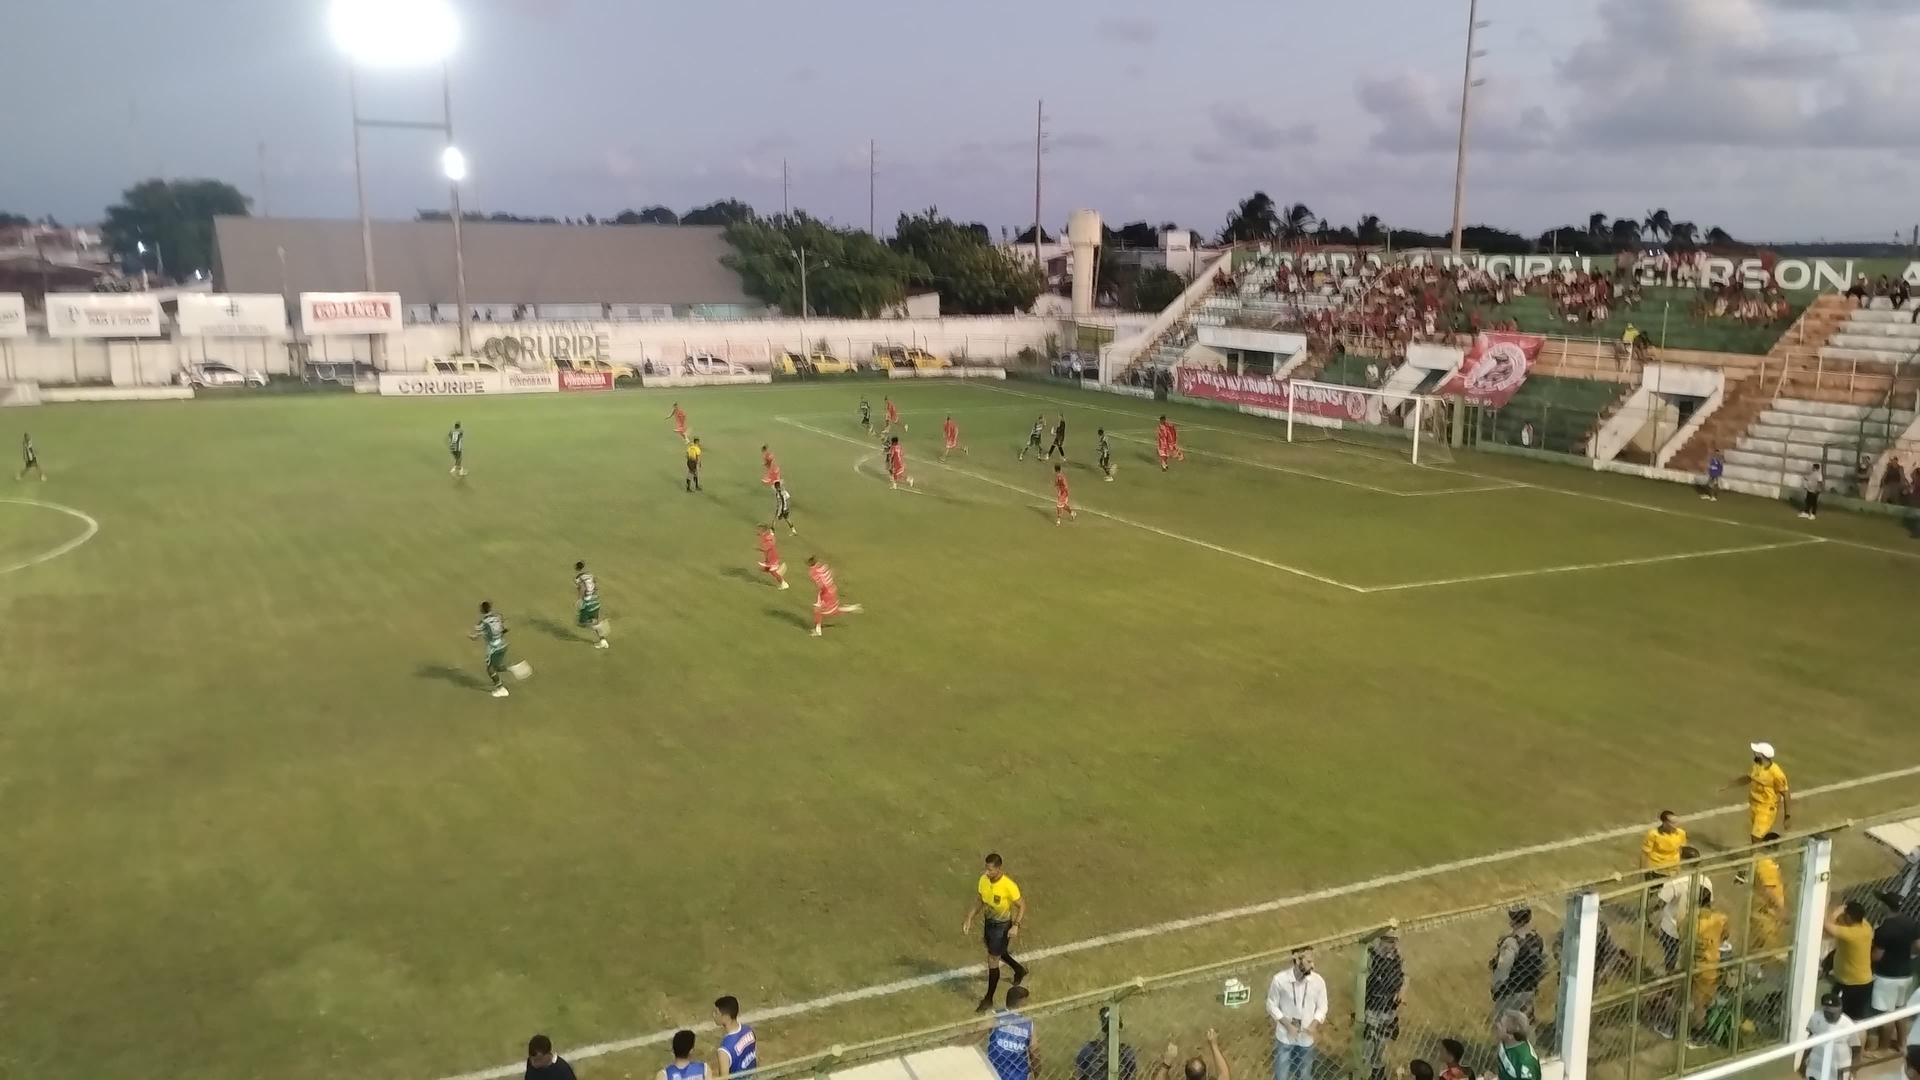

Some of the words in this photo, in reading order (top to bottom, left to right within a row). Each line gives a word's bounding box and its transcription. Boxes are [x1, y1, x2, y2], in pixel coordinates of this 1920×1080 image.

[1396, 254, 1592, 284] NICIPAL
[315, 300, 390, 319] CORINGA
[484, 335, 611, 362] CORURIPE
[398, 381, 485, 394] CORURIPE
[509, 374, 552, 387] PINDORAMA
[563, 373, 606, 387] PINDORAMA
[1281, 381, 1345, 407] PNEDENSE
